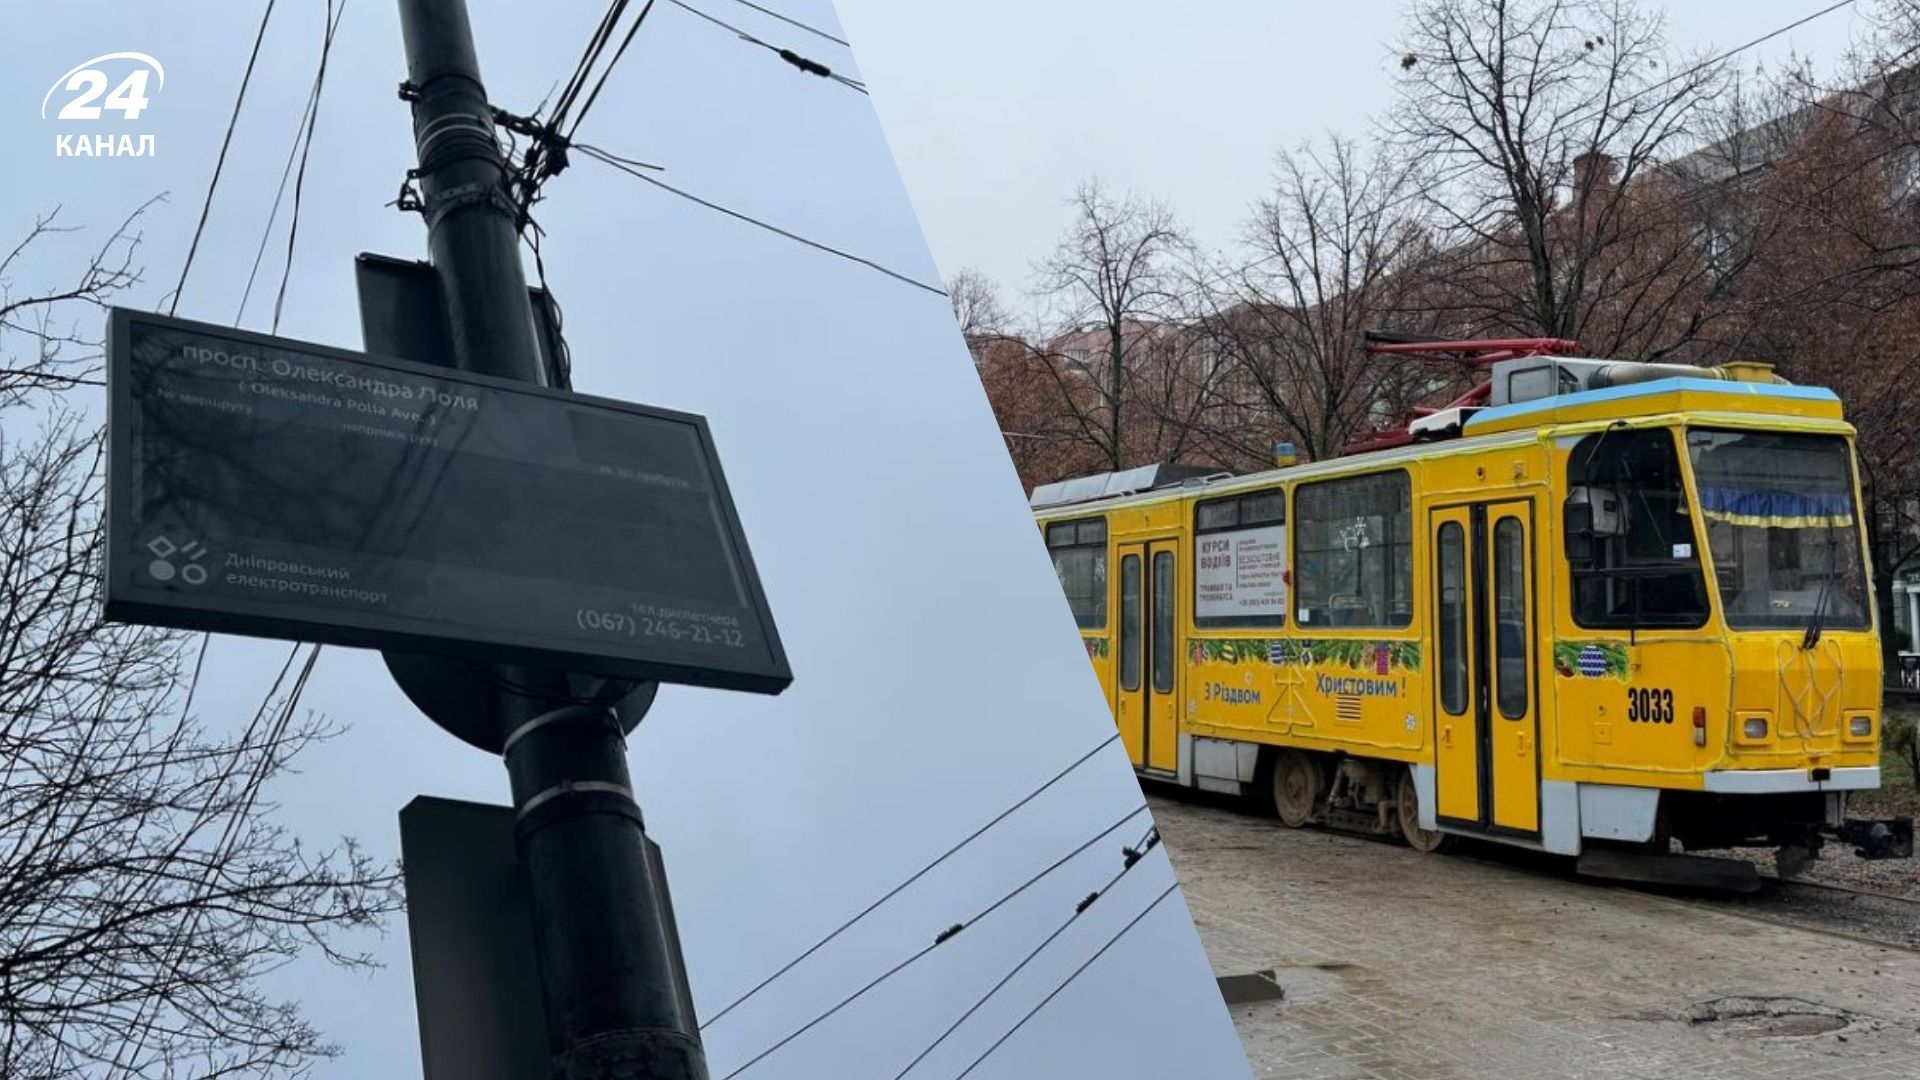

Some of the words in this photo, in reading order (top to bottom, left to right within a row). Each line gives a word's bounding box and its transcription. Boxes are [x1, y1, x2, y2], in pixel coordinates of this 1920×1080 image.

[271, 358, 413, 400] Олександра
[418, 386, 479, 411] Поля
[346, 398, 387, 416] Polia
[1202, 538, 1230, 554] КУРСИ
[225, 552, 350, 580] Дніпровський
[1201, 554, 1231, 570] ВОДІЇВ
[225, 573, 387, 604] електротранспорт
[576, 608, 636, 637] (067)
[642, 616, 745, 648] 246-21-12
[1213, 683, 1261, 704] Різдвом
[1316, 672, 1397, 698] Христовим
[1627, 687, 1674, 724] 3033
